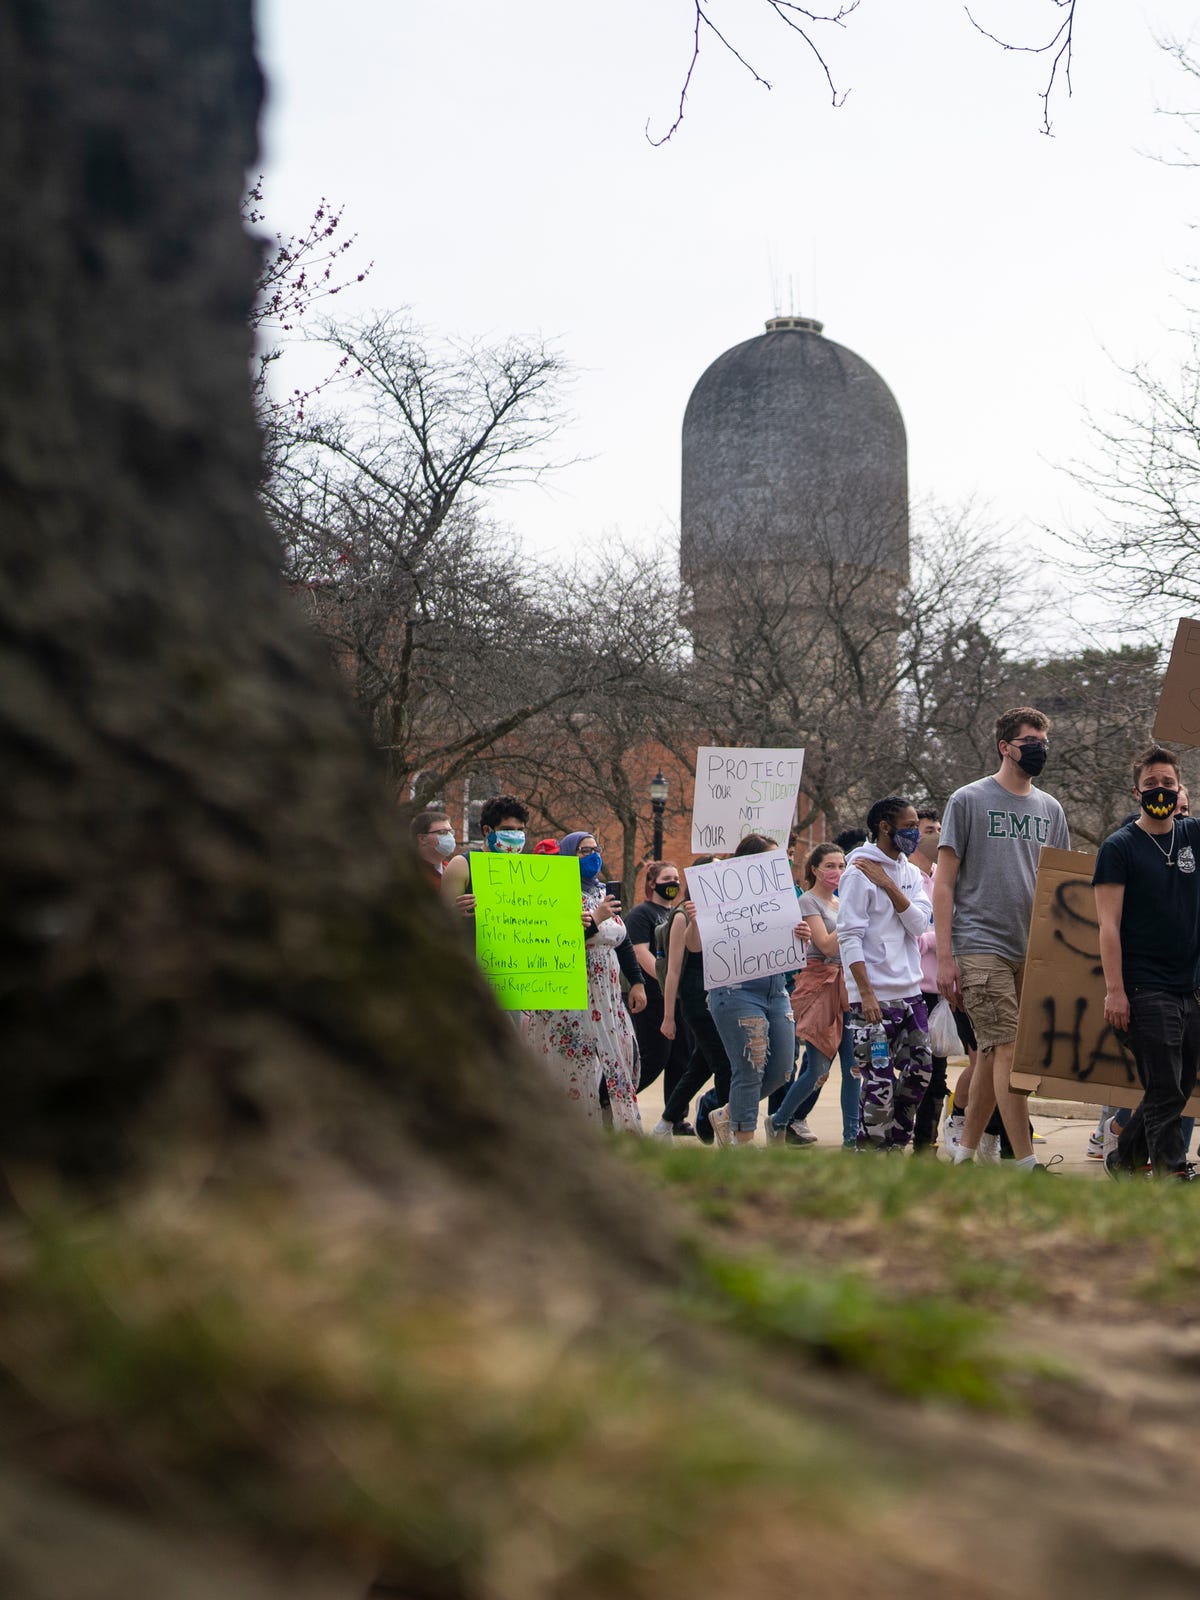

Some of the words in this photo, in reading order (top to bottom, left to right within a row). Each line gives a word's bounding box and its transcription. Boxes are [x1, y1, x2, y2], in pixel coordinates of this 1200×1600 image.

[708, 754, 799, 781] PROTECT
[708, 783, 732, 800] YOUR
[739, 805, 765, 821] NOT
[694, 822, 727, 848] YOUR
[986, 809, 1051, 844] EMU
[488, 857, 550, 886] EMU
[698, 868, 744, 907] NO
[747, 857, 793, 896] ONE
[716, 898, 781, 924] deserves
[723, 924, 740, 938] to
[750, 918, 768, 934] be
